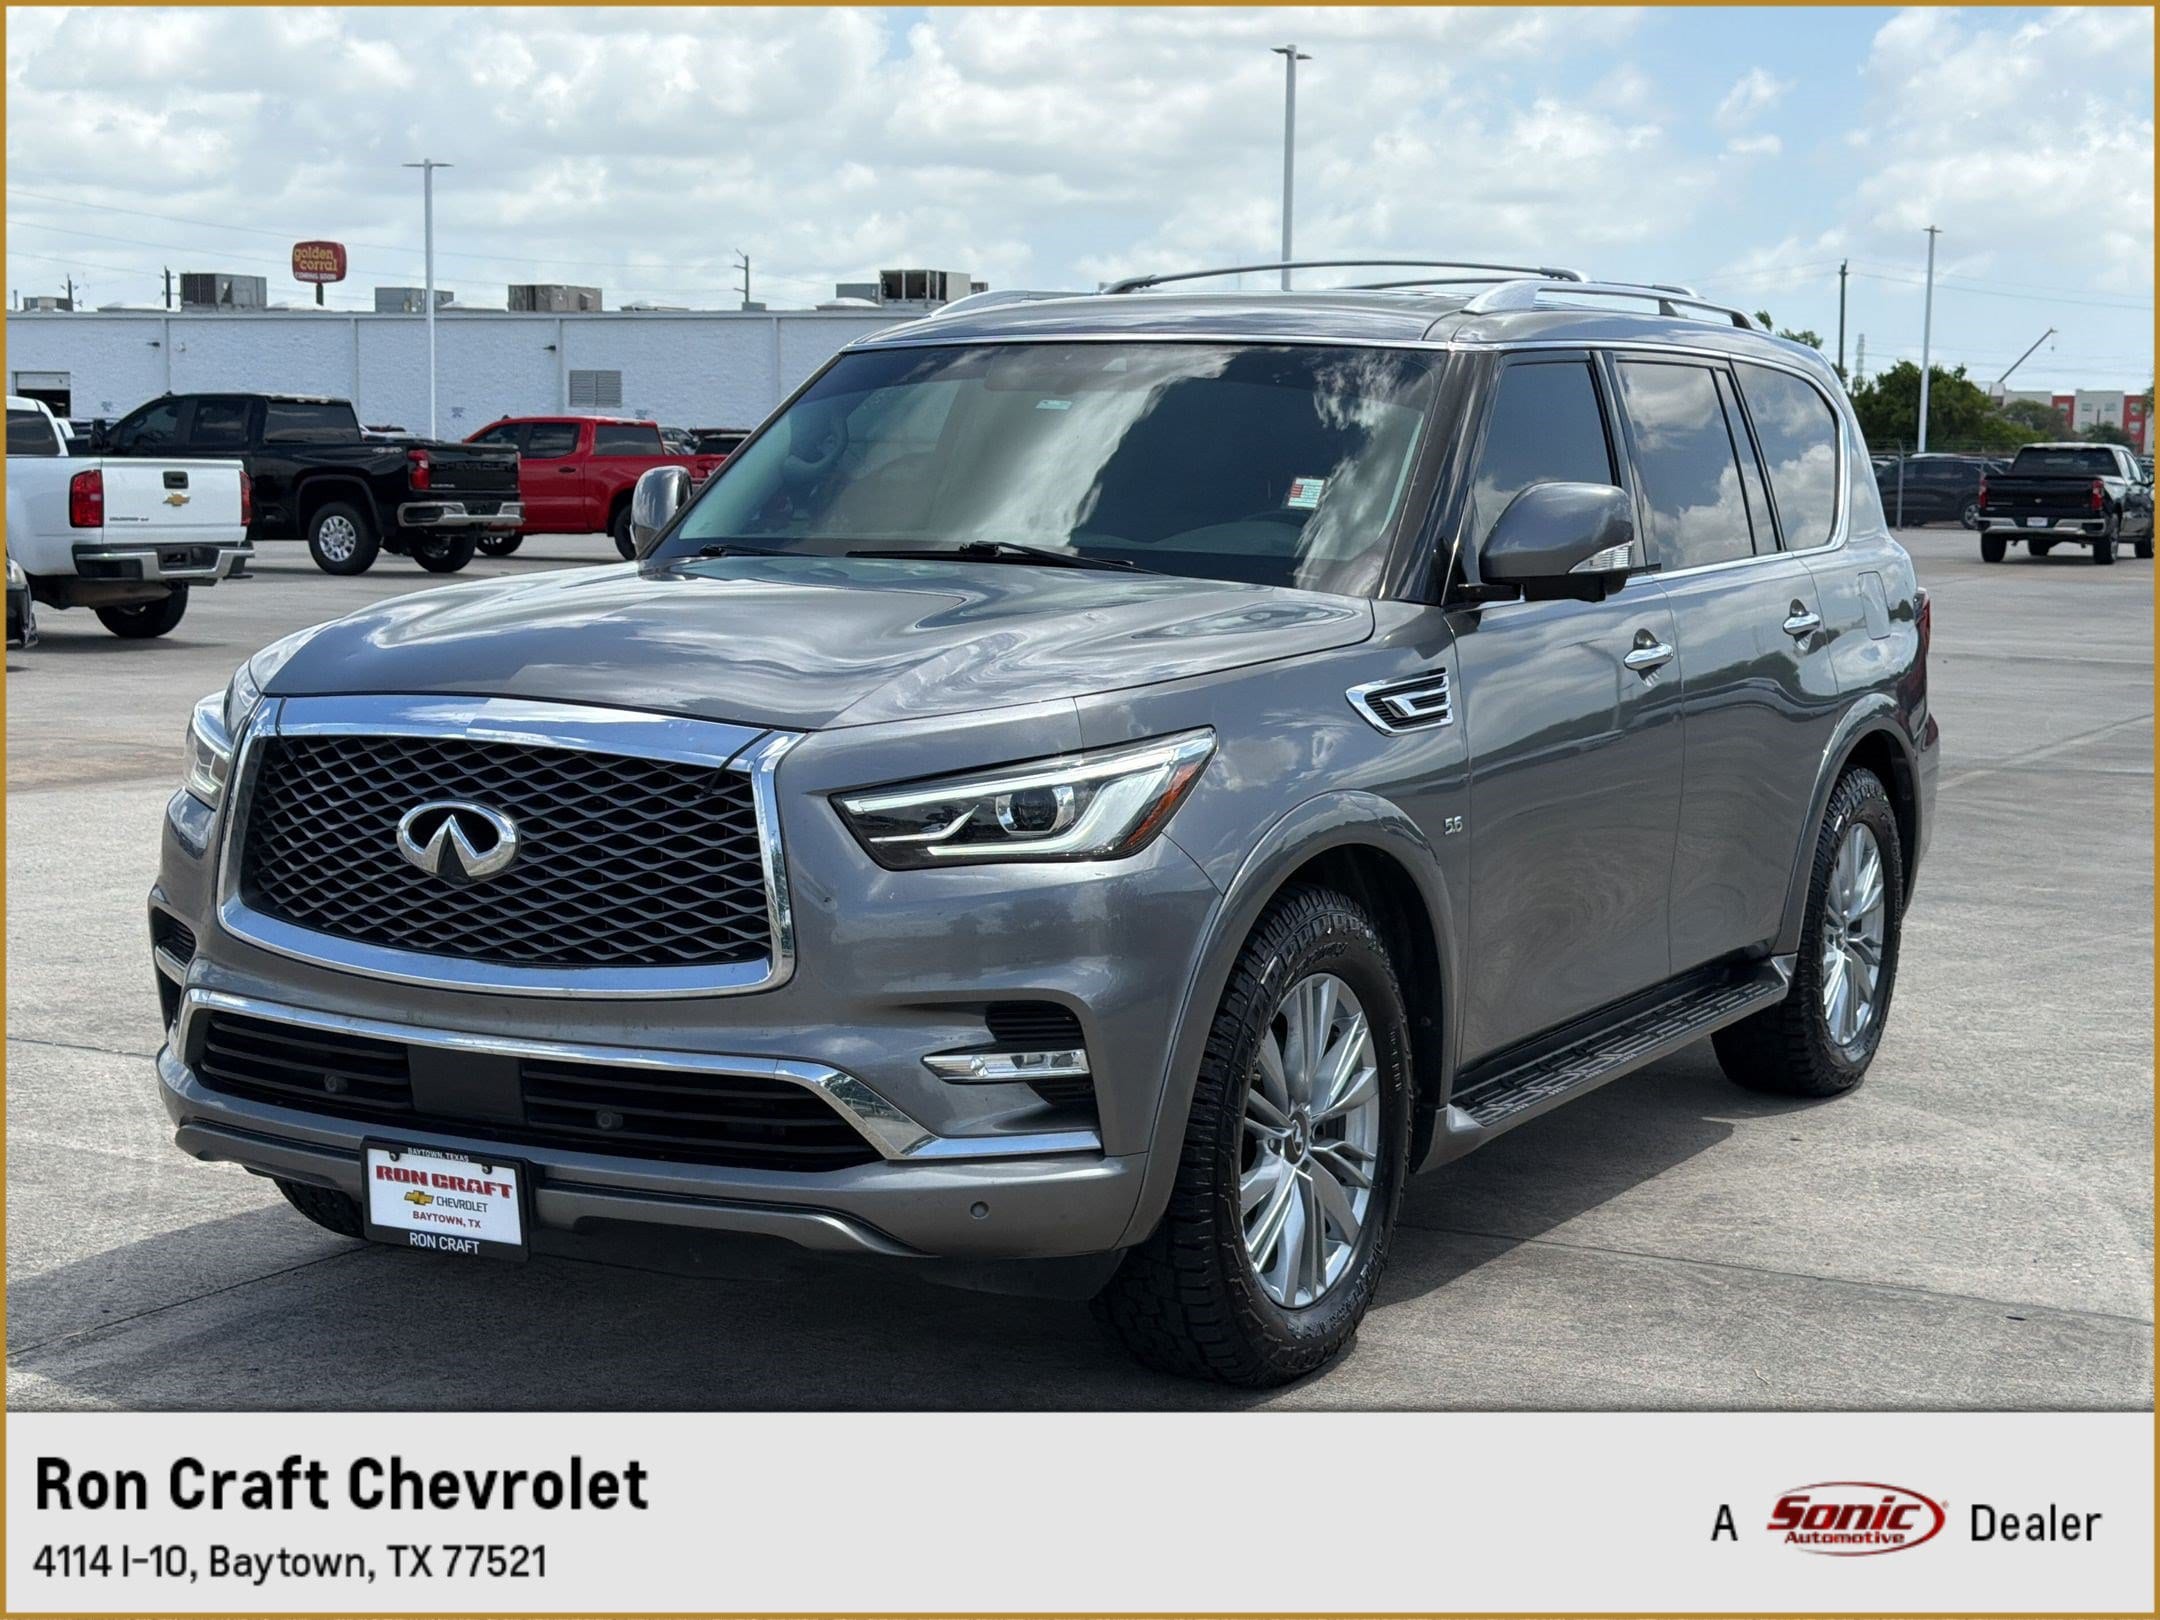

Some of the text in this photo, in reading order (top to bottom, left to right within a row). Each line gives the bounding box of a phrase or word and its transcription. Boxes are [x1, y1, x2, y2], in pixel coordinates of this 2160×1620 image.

[295, 246, 333, 261] golden
[300, 259, 337, 271] corral
[445, 1152, 470, 1162] TEXAS
[376, 1165, 513, 1199] RON CRAFT
[436, 1196, 489, 1213] CHEVROLET
[412, 1210, 482, 1229] BAYTOWN, TX
[409, 1232, 480, 1254] RON CRAFT
